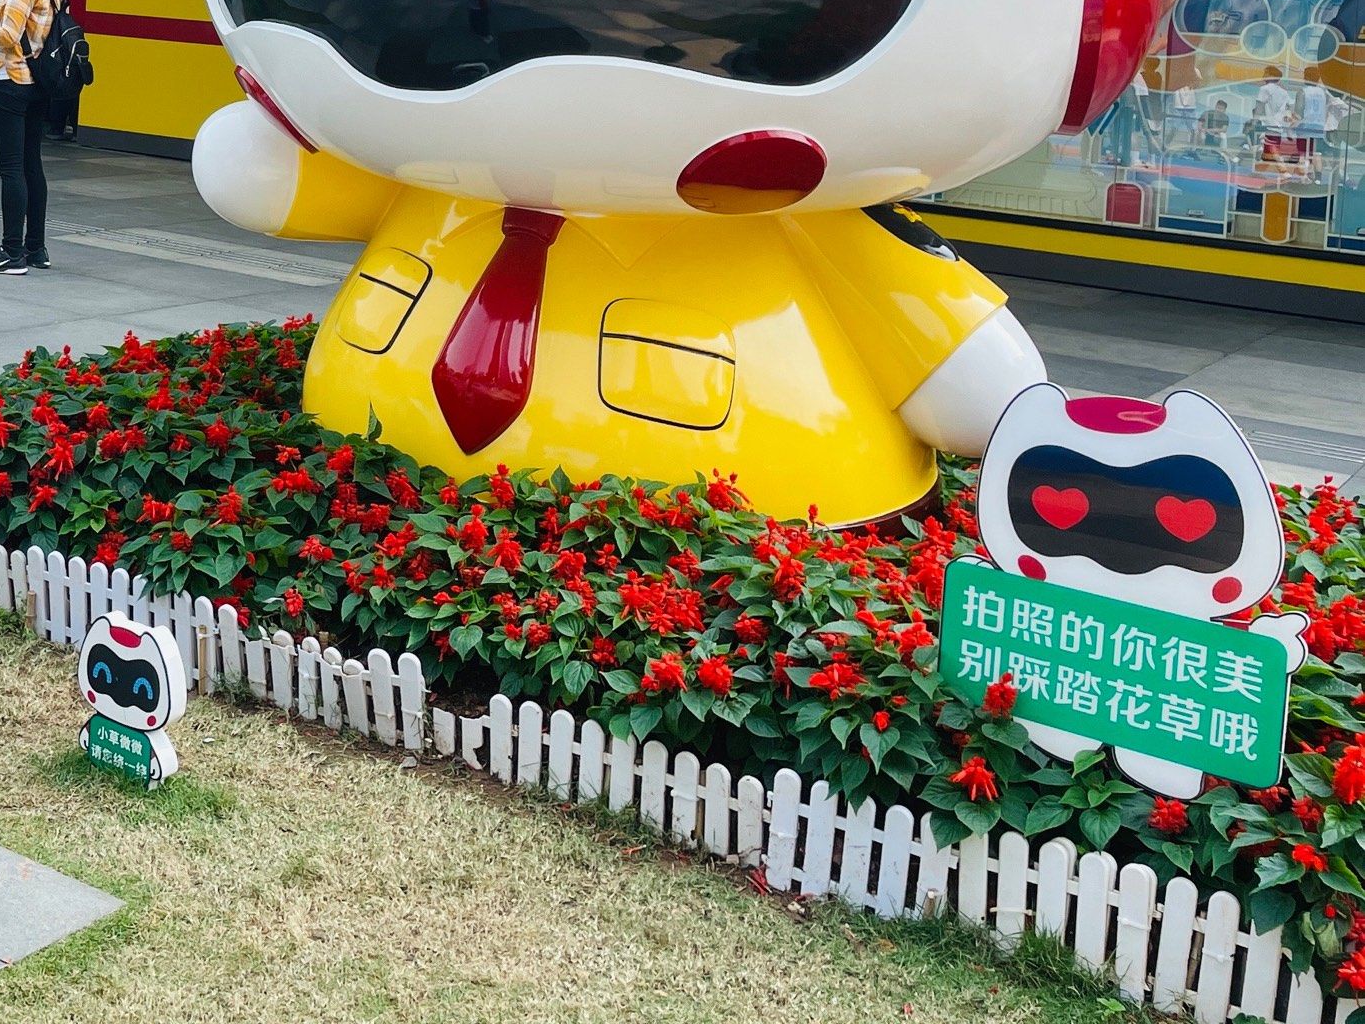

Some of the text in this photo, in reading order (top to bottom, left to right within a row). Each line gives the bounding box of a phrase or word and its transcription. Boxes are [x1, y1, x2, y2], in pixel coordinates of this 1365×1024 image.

[956, 638, 1260, 761] 别踩踏花草哦
[961, 585, 1264, 704] 拍照的你很美
